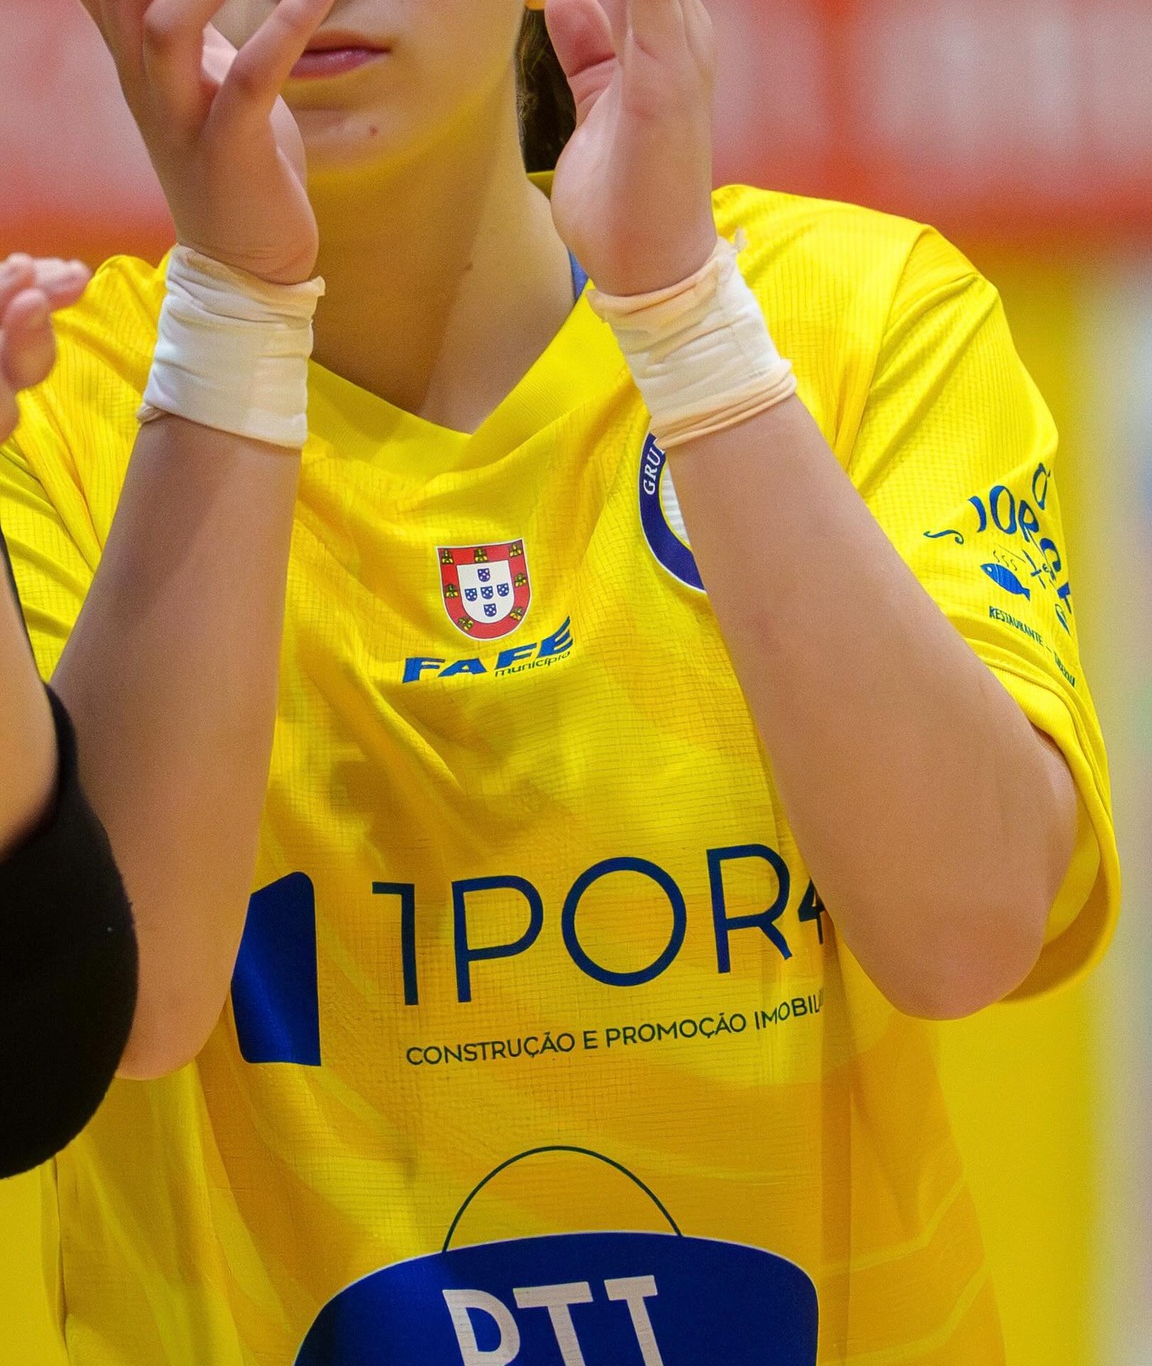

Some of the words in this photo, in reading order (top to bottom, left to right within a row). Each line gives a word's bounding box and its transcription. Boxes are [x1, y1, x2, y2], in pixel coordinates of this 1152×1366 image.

[402, 615, 574, 684] FAFE
[406, 1031, 576, 1067] CONSTRUÇÃO
[583, 1030, 599, 1050] E
[606, 1012, 747, 1048] PROMOÇÃO
